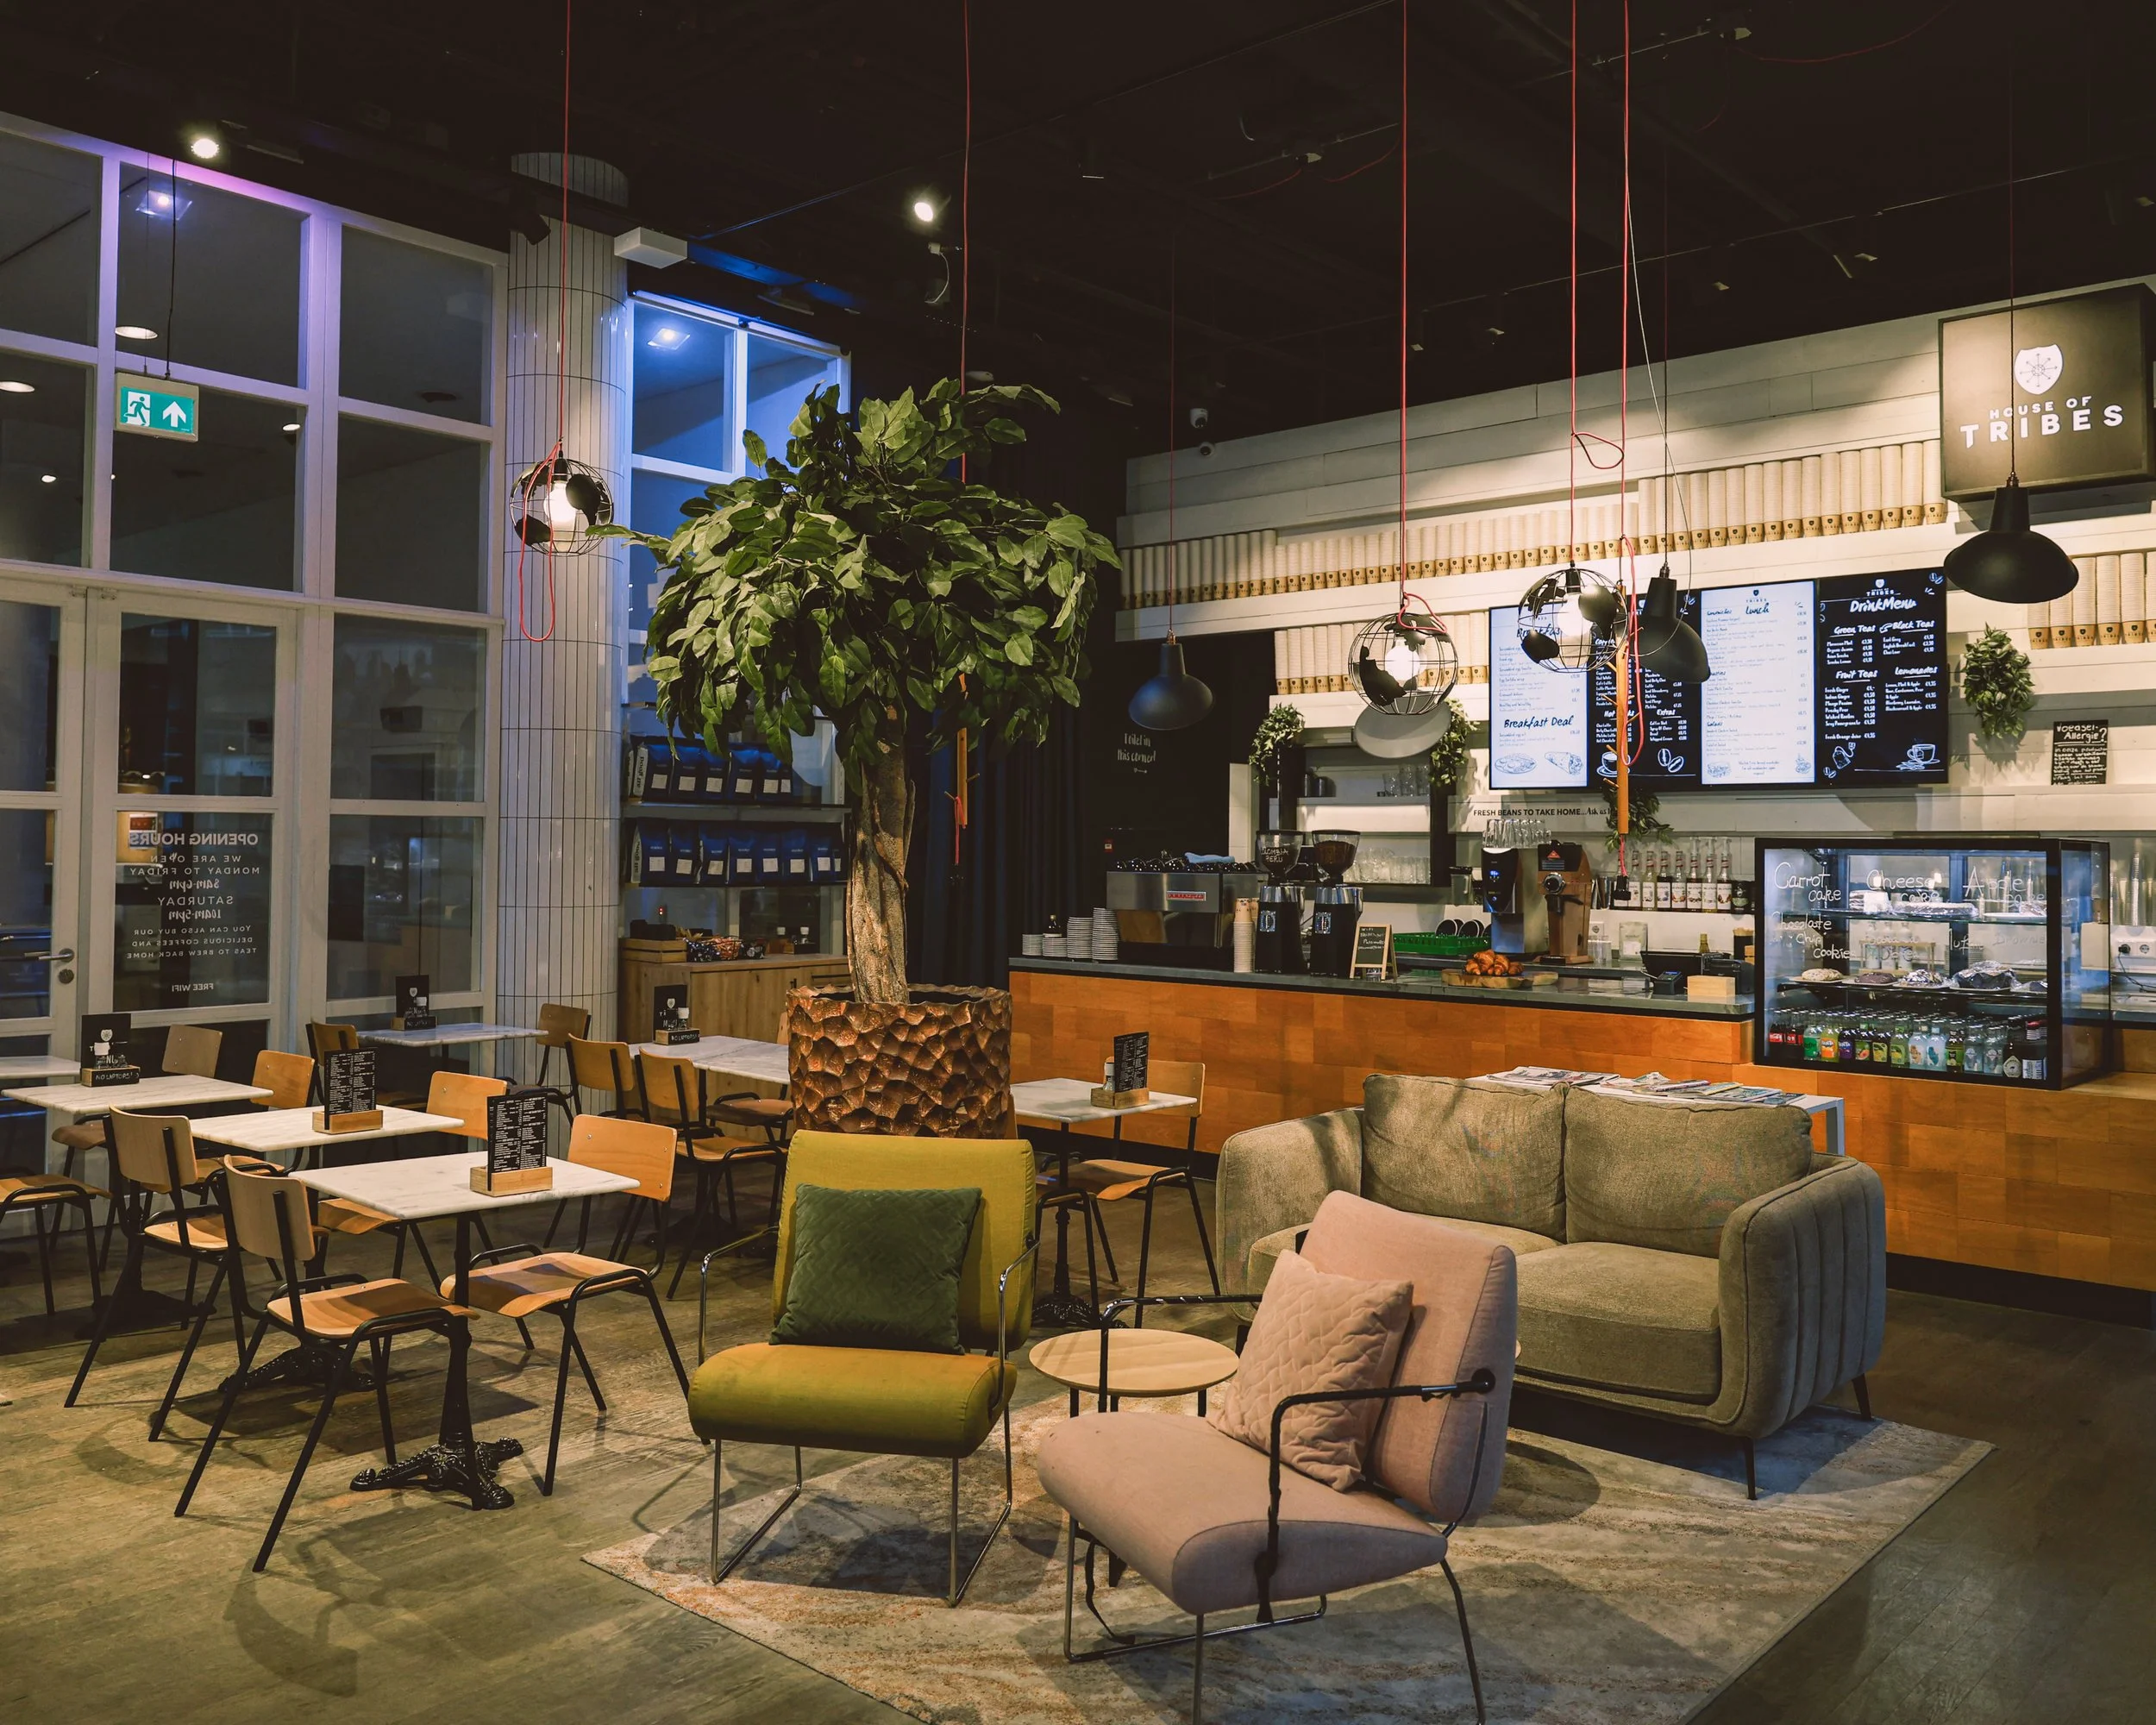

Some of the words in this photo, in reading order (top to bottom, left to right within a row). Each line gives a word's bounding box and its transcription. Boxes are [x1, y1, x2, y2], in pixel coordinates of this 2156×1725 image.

[1989, 401, 2053, 419] HOUSE
[2065, 396, 2092, 409] OF
[1960, 405, 2123, 448] TRIBES
[1745, 602, 1770, 615] Lunch
[1833, 626, 1856, 635] Green
[1858, 624, 1876, 633] Teas
[1892, 620, 1915, 630] Black
[1915, 619, 1934, 628] Teas
[1835, 670, 1856, 680] Fruit
[1858, 669, 1878, 678] Teas
[1895, 666, 1938, 675] Lemonades
[1504, 715, 1548, 730] Breakfast
[1551, 714, 1574, 726] Deal
[1774, 862, 1831, 889] Carrot
[1808, 885, 1842, 902] cake
